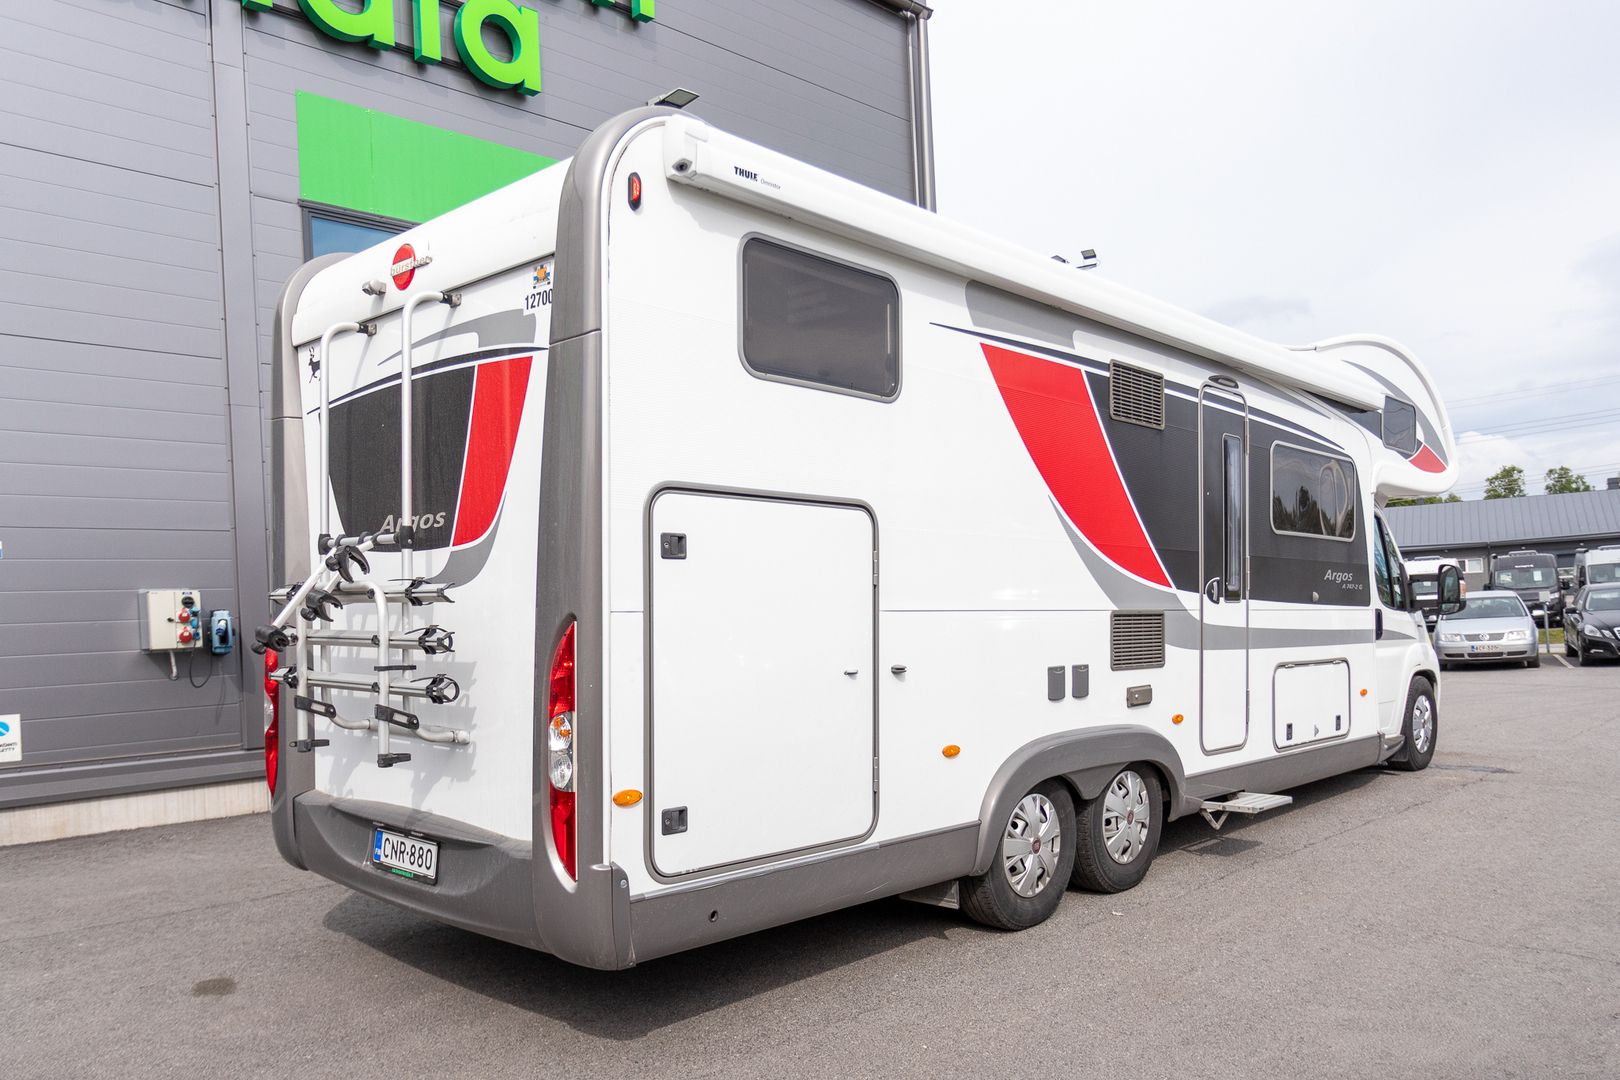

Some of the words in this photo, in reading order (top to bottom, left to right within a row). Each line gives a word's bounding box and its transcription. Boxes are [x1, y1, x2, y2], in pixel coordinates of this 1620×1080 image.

[734, 165, 758, 182] THULE
[525, 288, 553, 310] 12700
[1323, 569, 1353, 584] Argos
[383, 837, 433, 871] CNR-880
